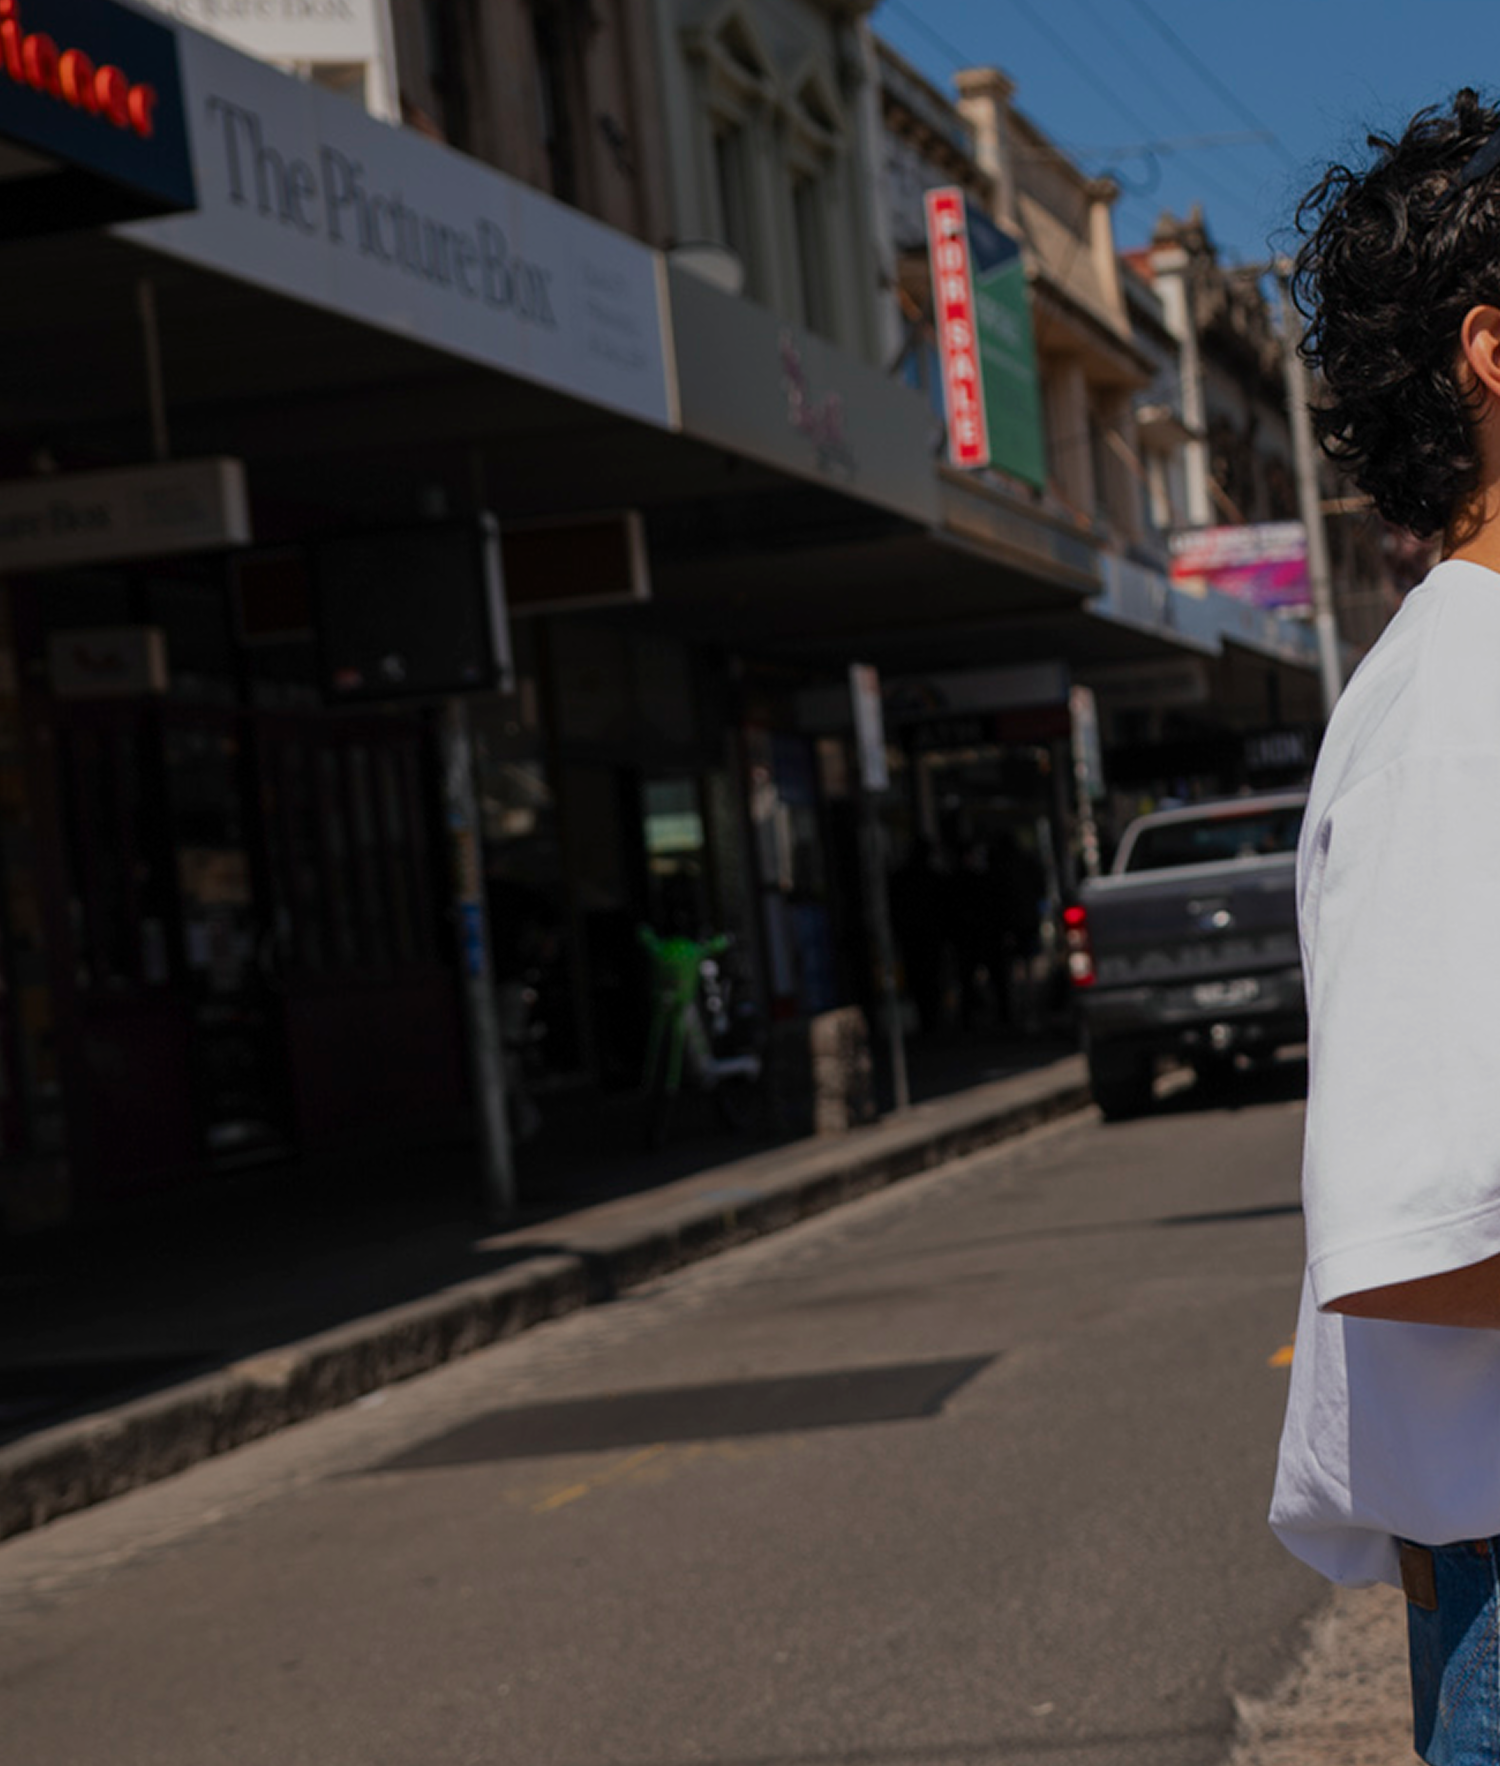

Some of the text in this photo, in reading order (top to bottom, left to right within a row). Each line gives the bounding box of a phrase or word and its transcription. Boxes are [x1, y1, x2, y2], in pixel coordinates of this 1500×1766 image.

[205, 92, 318, 236] The
[320, 143, 480, 299] Picture
[475, 215, 559, 332] Box
[937, 213, 979, 442] FOR SALE
